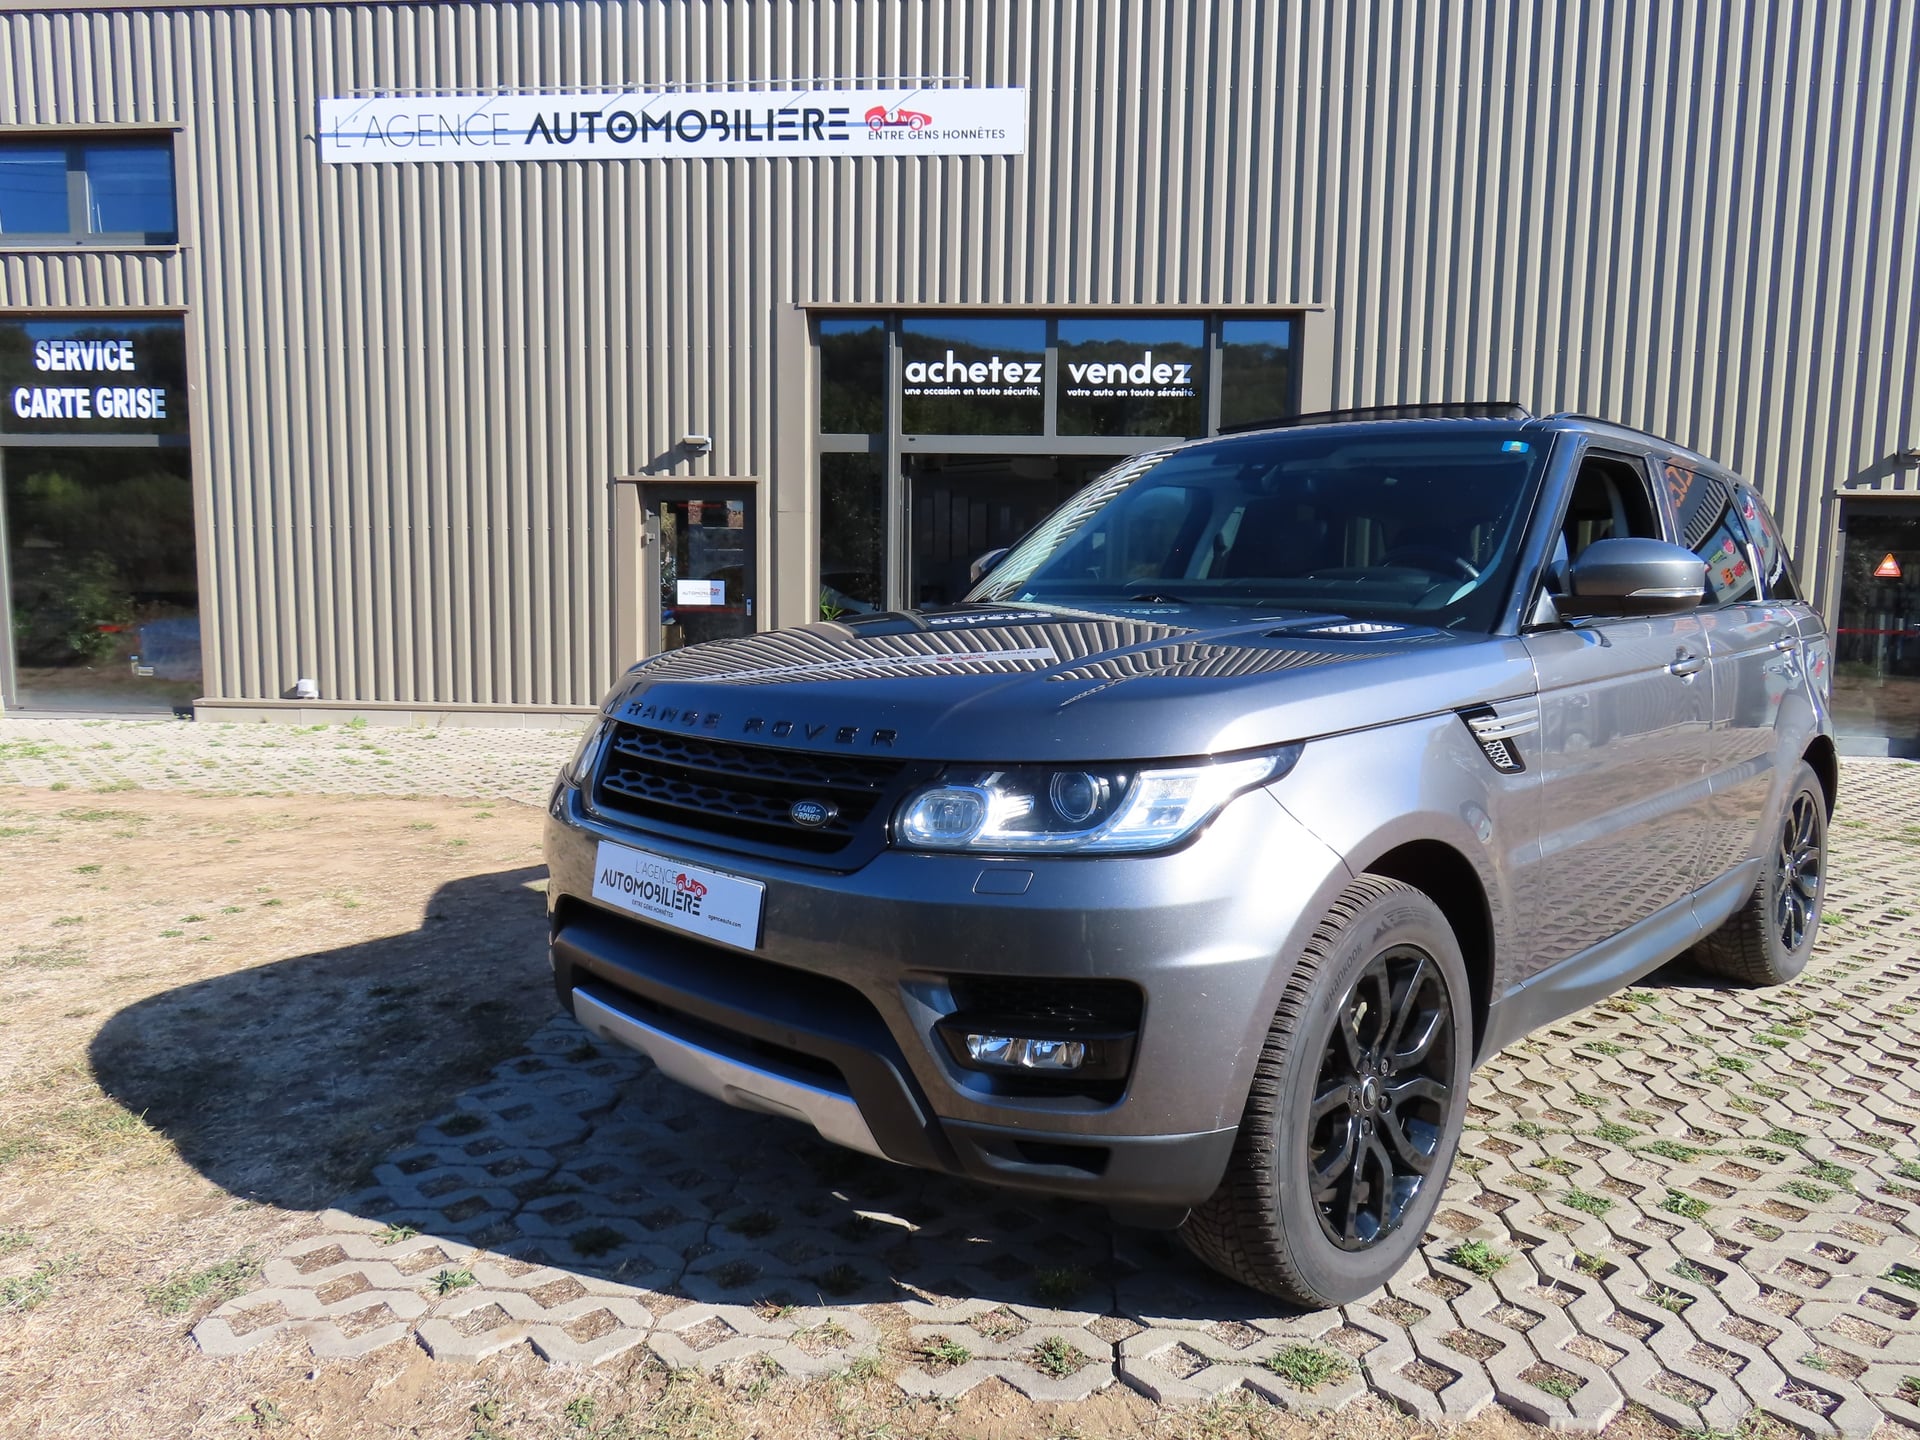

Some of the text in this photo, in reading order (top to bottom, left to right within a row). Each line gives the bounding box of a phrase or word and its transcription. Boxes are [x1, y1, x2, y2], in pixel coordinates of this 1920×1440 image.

[334, 108, 850, 148] L'AGENCE AUTOMOBILIERE
[889, 112, 894, 121] 1
[868, 126, 1006, 140] ENTRE GENS HONNÊTES
[35, 340, 135, 371] SERVICE
[905, 350, 1042, 384] achetez
[1068, 351, 1192, 384] vendez
[14, 387, 166, 419] CARTE GRISE
[923, 387, 961, 396] occasion
[976, 387, 1001, 396] toute
[1003, 386, 1041, 396] sécurité.
[1067, 389, 1090, 397] votre
[1093, 388, 1114, 397] auto
[1130, 388, 1155, 397] toute
[627, 702, 898, 748] RANGE ROVER
[635, 859, 678, 885] L'AGENCE
